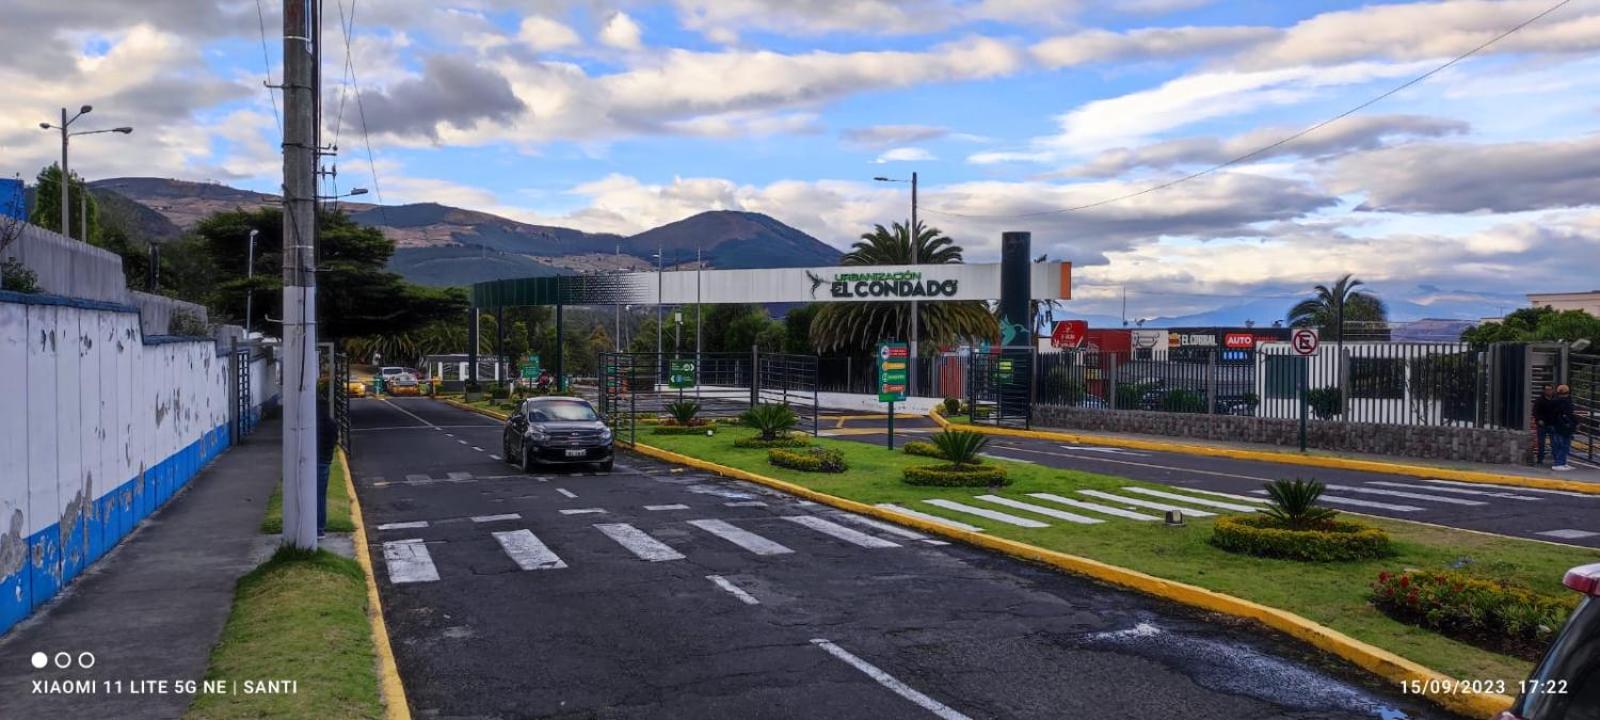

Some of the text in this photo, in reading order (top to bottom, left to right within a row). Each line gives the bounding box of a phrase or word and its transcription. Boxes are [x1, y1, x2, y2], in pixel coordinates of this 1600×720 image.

[834, 270, 922, 281] URBANIZACIÓN
[831, 280, 958, 297] EL CONDADO
[1227, 336, 1252, 345] AUTO
